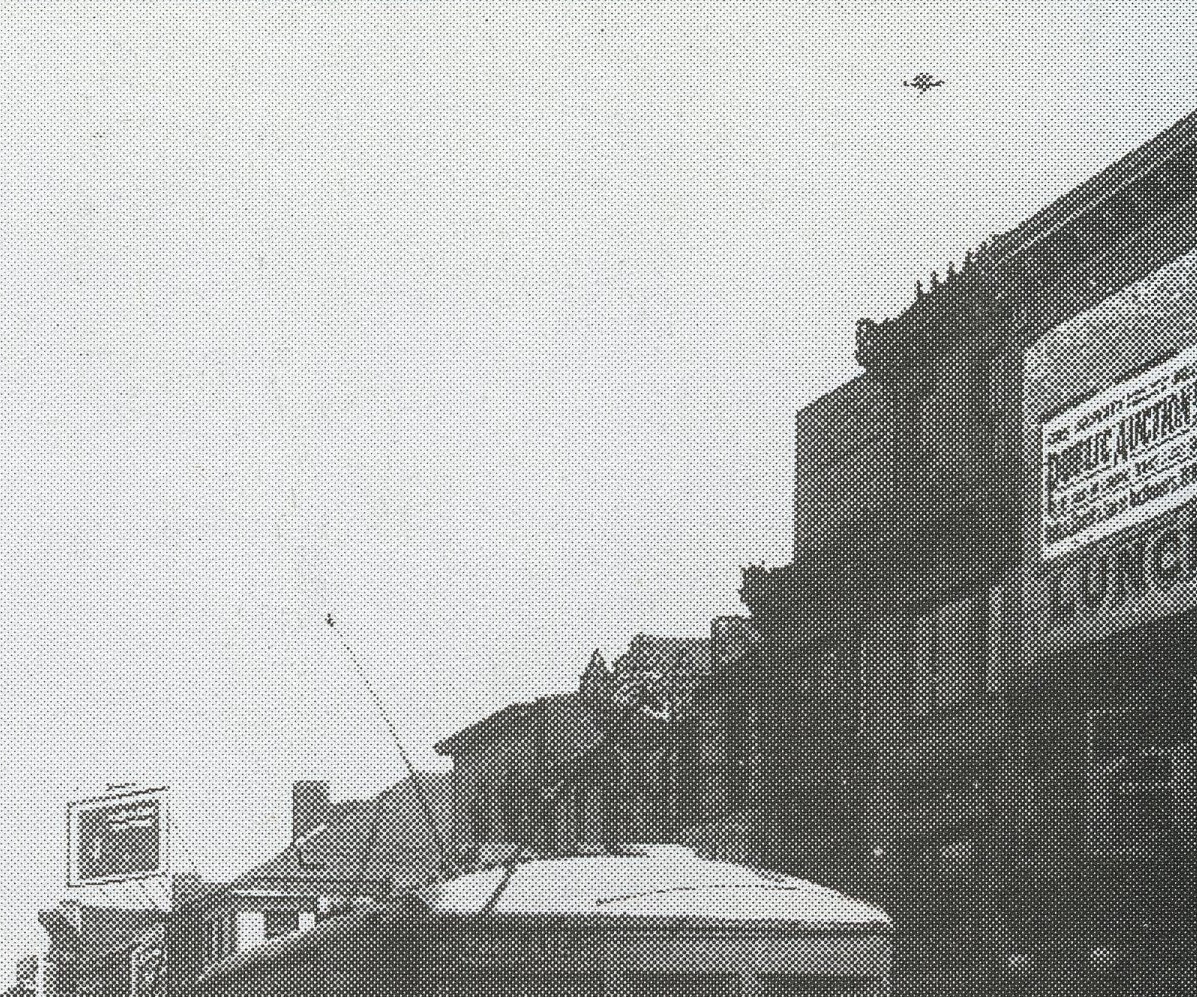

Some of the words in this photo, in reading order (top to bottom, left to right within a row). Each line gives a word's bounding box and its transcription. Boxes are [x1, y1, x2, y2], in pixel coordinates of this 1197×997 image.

[1048, 428, 1112, 490] PUBLIC
[1114, 386, 1191, 465] AUCTION
[1049, 529, 1197, 626] LUNC
